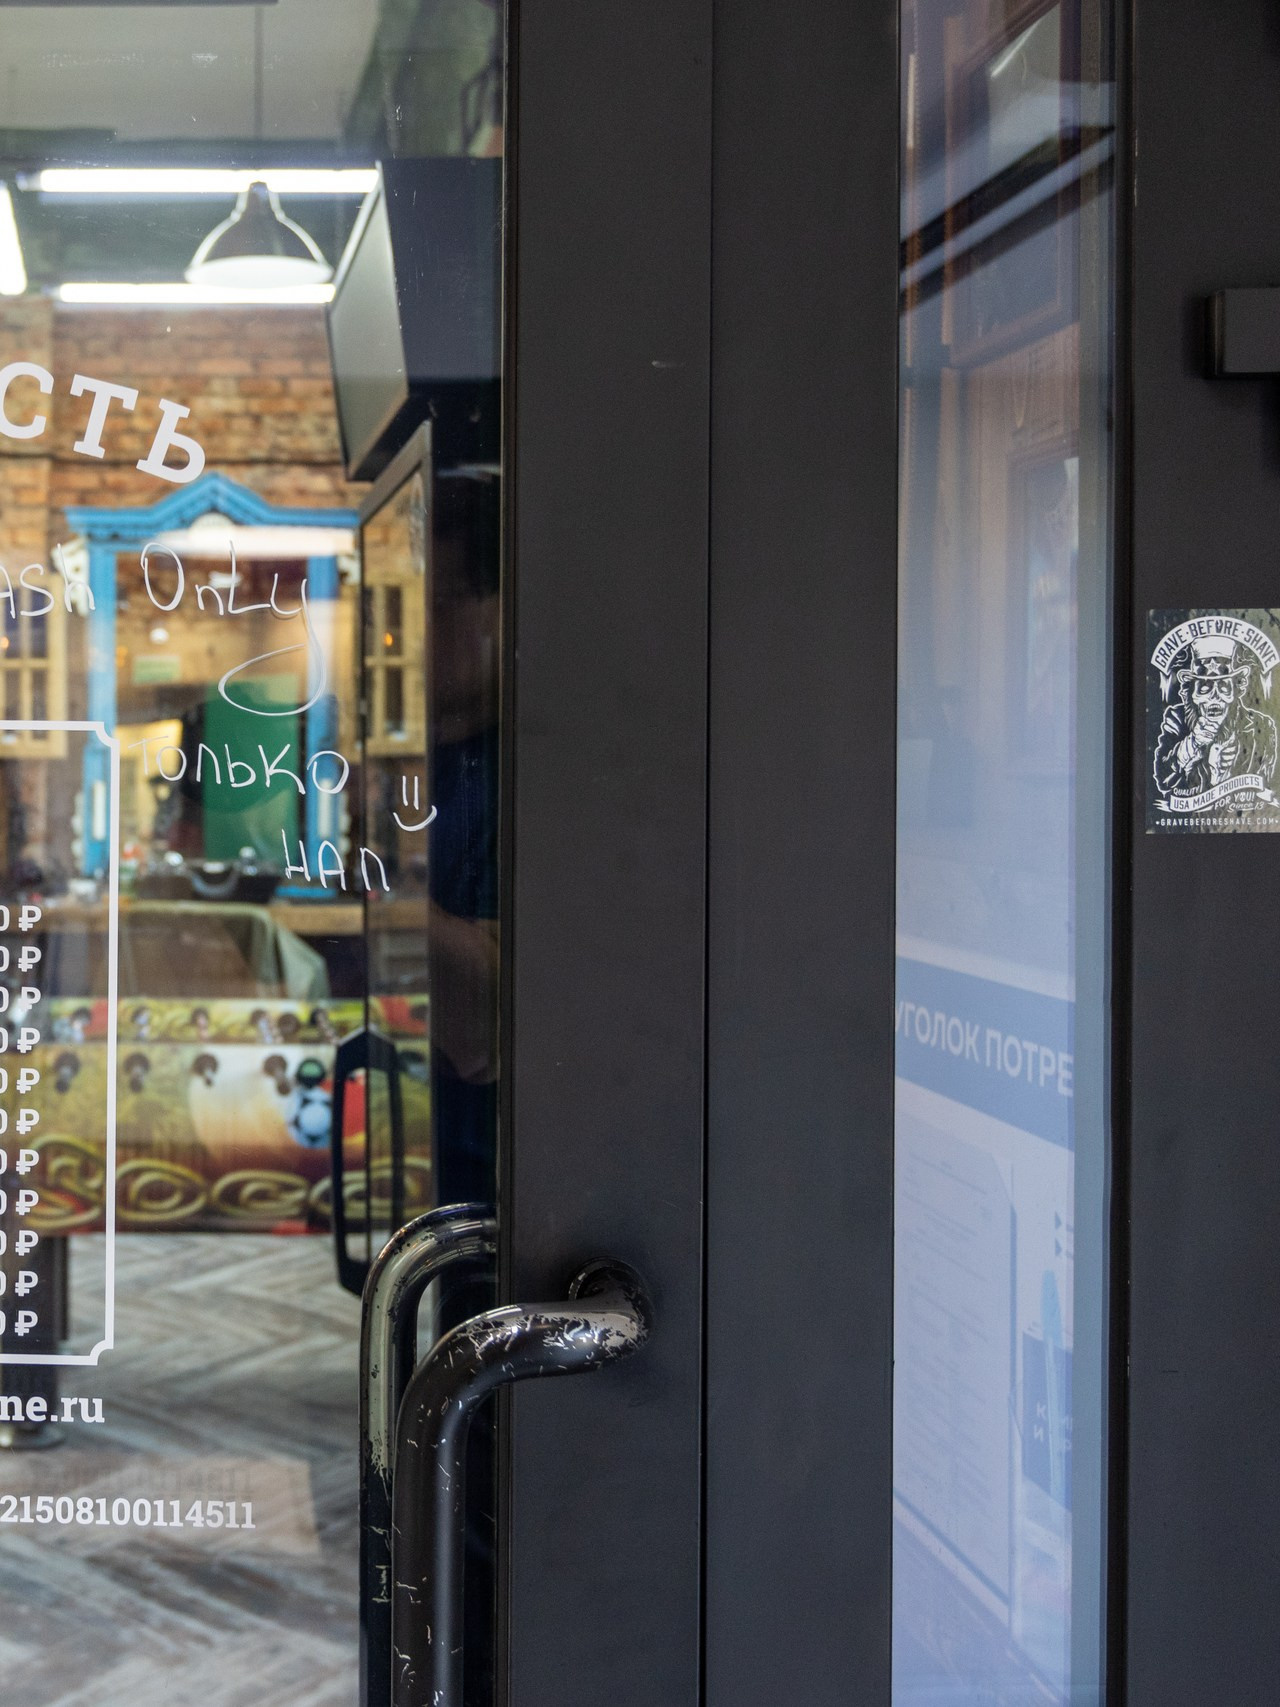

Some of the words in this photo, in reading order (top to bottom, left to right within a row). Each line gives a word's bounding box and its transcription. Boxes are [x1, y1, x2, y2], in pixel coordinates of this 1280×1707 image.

[1155, 631, 1187, 668] GRAVE
[1188, 619, 1242, 638] BEFORE
[1244, 629, 1276, 668] SHAVE
[1173, 785, 1200, 796] QUALITY
[1174, 800, 1190, 810] USA
[1192, 789, 1216, 808] MADE
[1218, 776, 1260, 796] PRODUCTS
